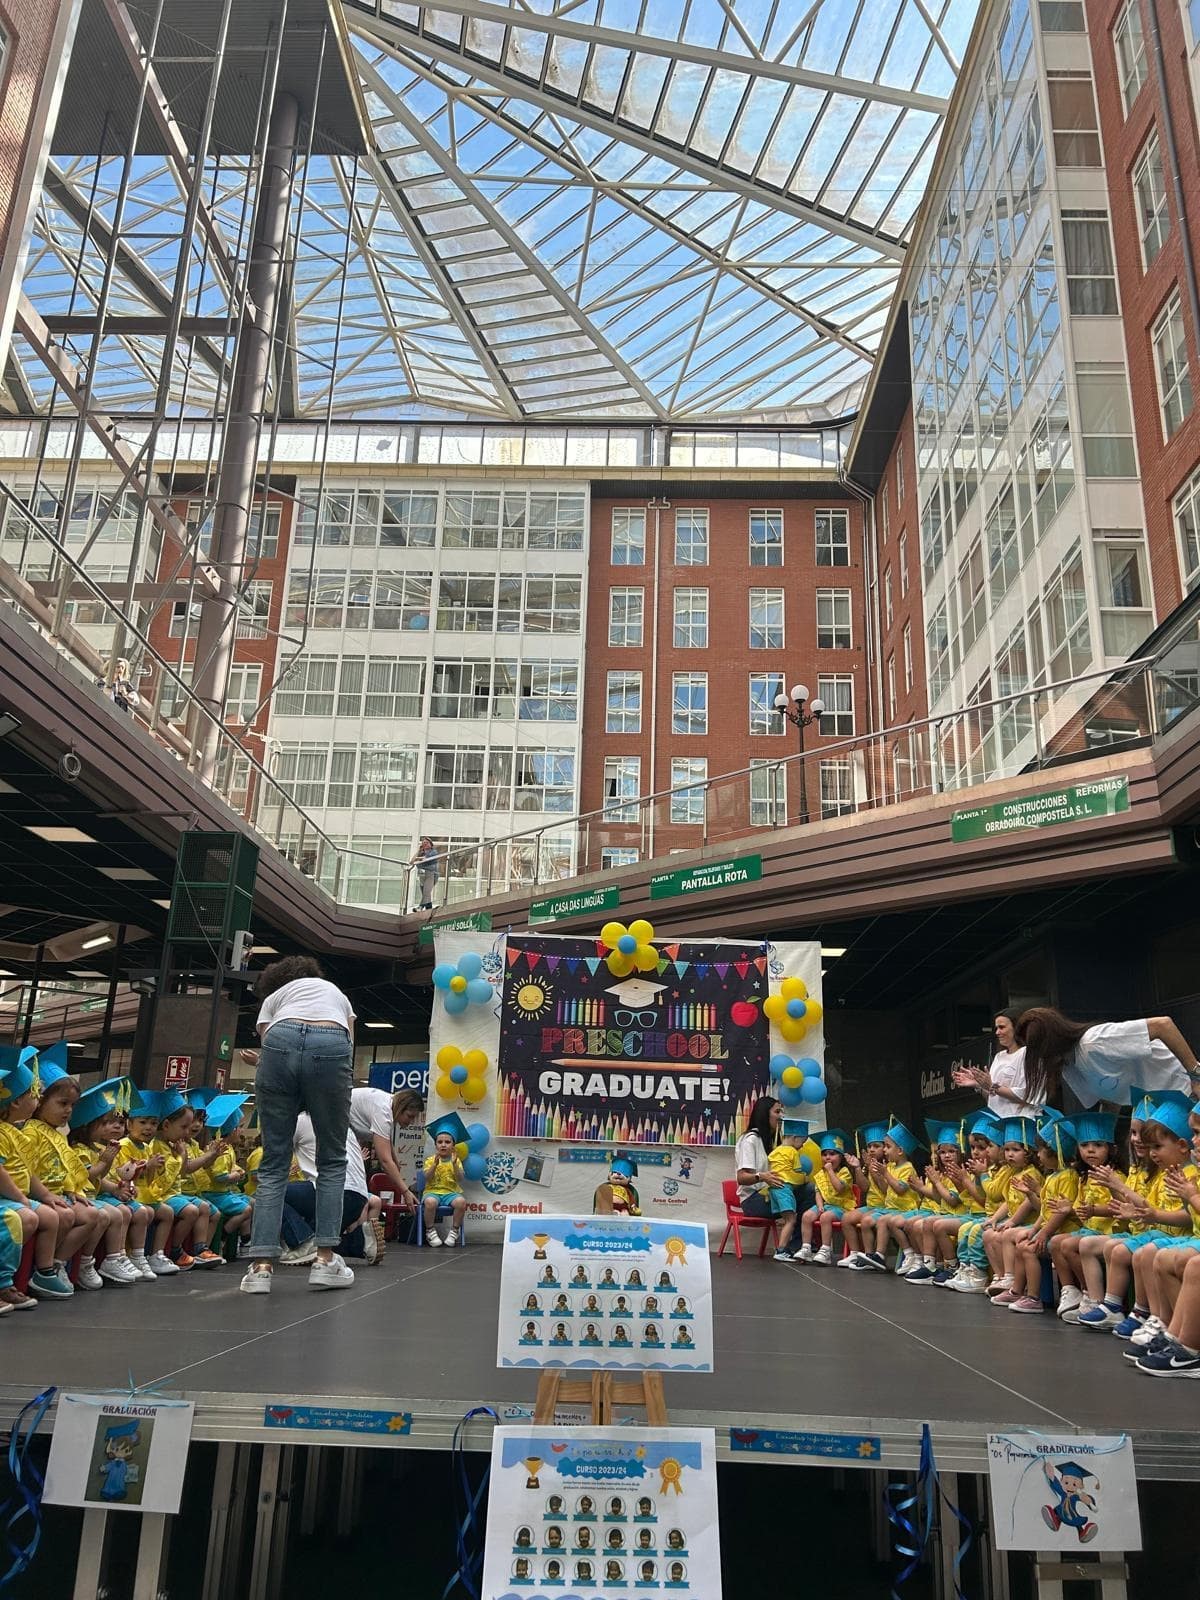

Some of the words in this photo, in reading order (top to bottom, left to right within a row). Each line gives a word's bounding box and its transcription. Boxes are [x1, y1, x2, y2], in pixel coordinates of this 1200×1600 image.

[1076, 779, 1123, 798] REFORMAS
[1003, 794, 1068, 816] CONSTRUCCIONES
[956, 811, 980, 821] PLANTA
[985, 816, 1026, 833] OBRADOIRO
[1026, 806, 1075, 825] COMPOSTELA
[1076, 805, 1084, 815] S.
[1085, 803, 1092, 814] L.
[651, 875, 669, 884] PLANTA
[681, 873, 723, 890] PANTALLA
[724, 869, 748, 883] ROTA
[549, 904, 554, 915] A
[554, 902, 569, 914] CASA
[569, 899, 580, 911] DAS
[581, 894, 604, 909] LINGUAS
[455, 920, 473, 930] SOLLA
[540, 1027, 729, 1059] PRESCHOOL
[538, 1071, 731, 1102] GRADUATE!
[920, 1071, 946, 1099] Galicia
[399, 1132, 422, 1140] Planta
[465, 1201, 487, 1213] rea
[492, 1200, 543, 1214] Central
[467, 1213, 492, 1221] CENTRO
[582, 1240, 604, 1248] CURSO
[604, 1241, 633, 1249] 2023/24
[1036, 1443, 1095, 1455] GRADUACIÓN
[576, 1464, 598, 1474] CURSO
[598, 1466, 627, 1475] 2023/24
